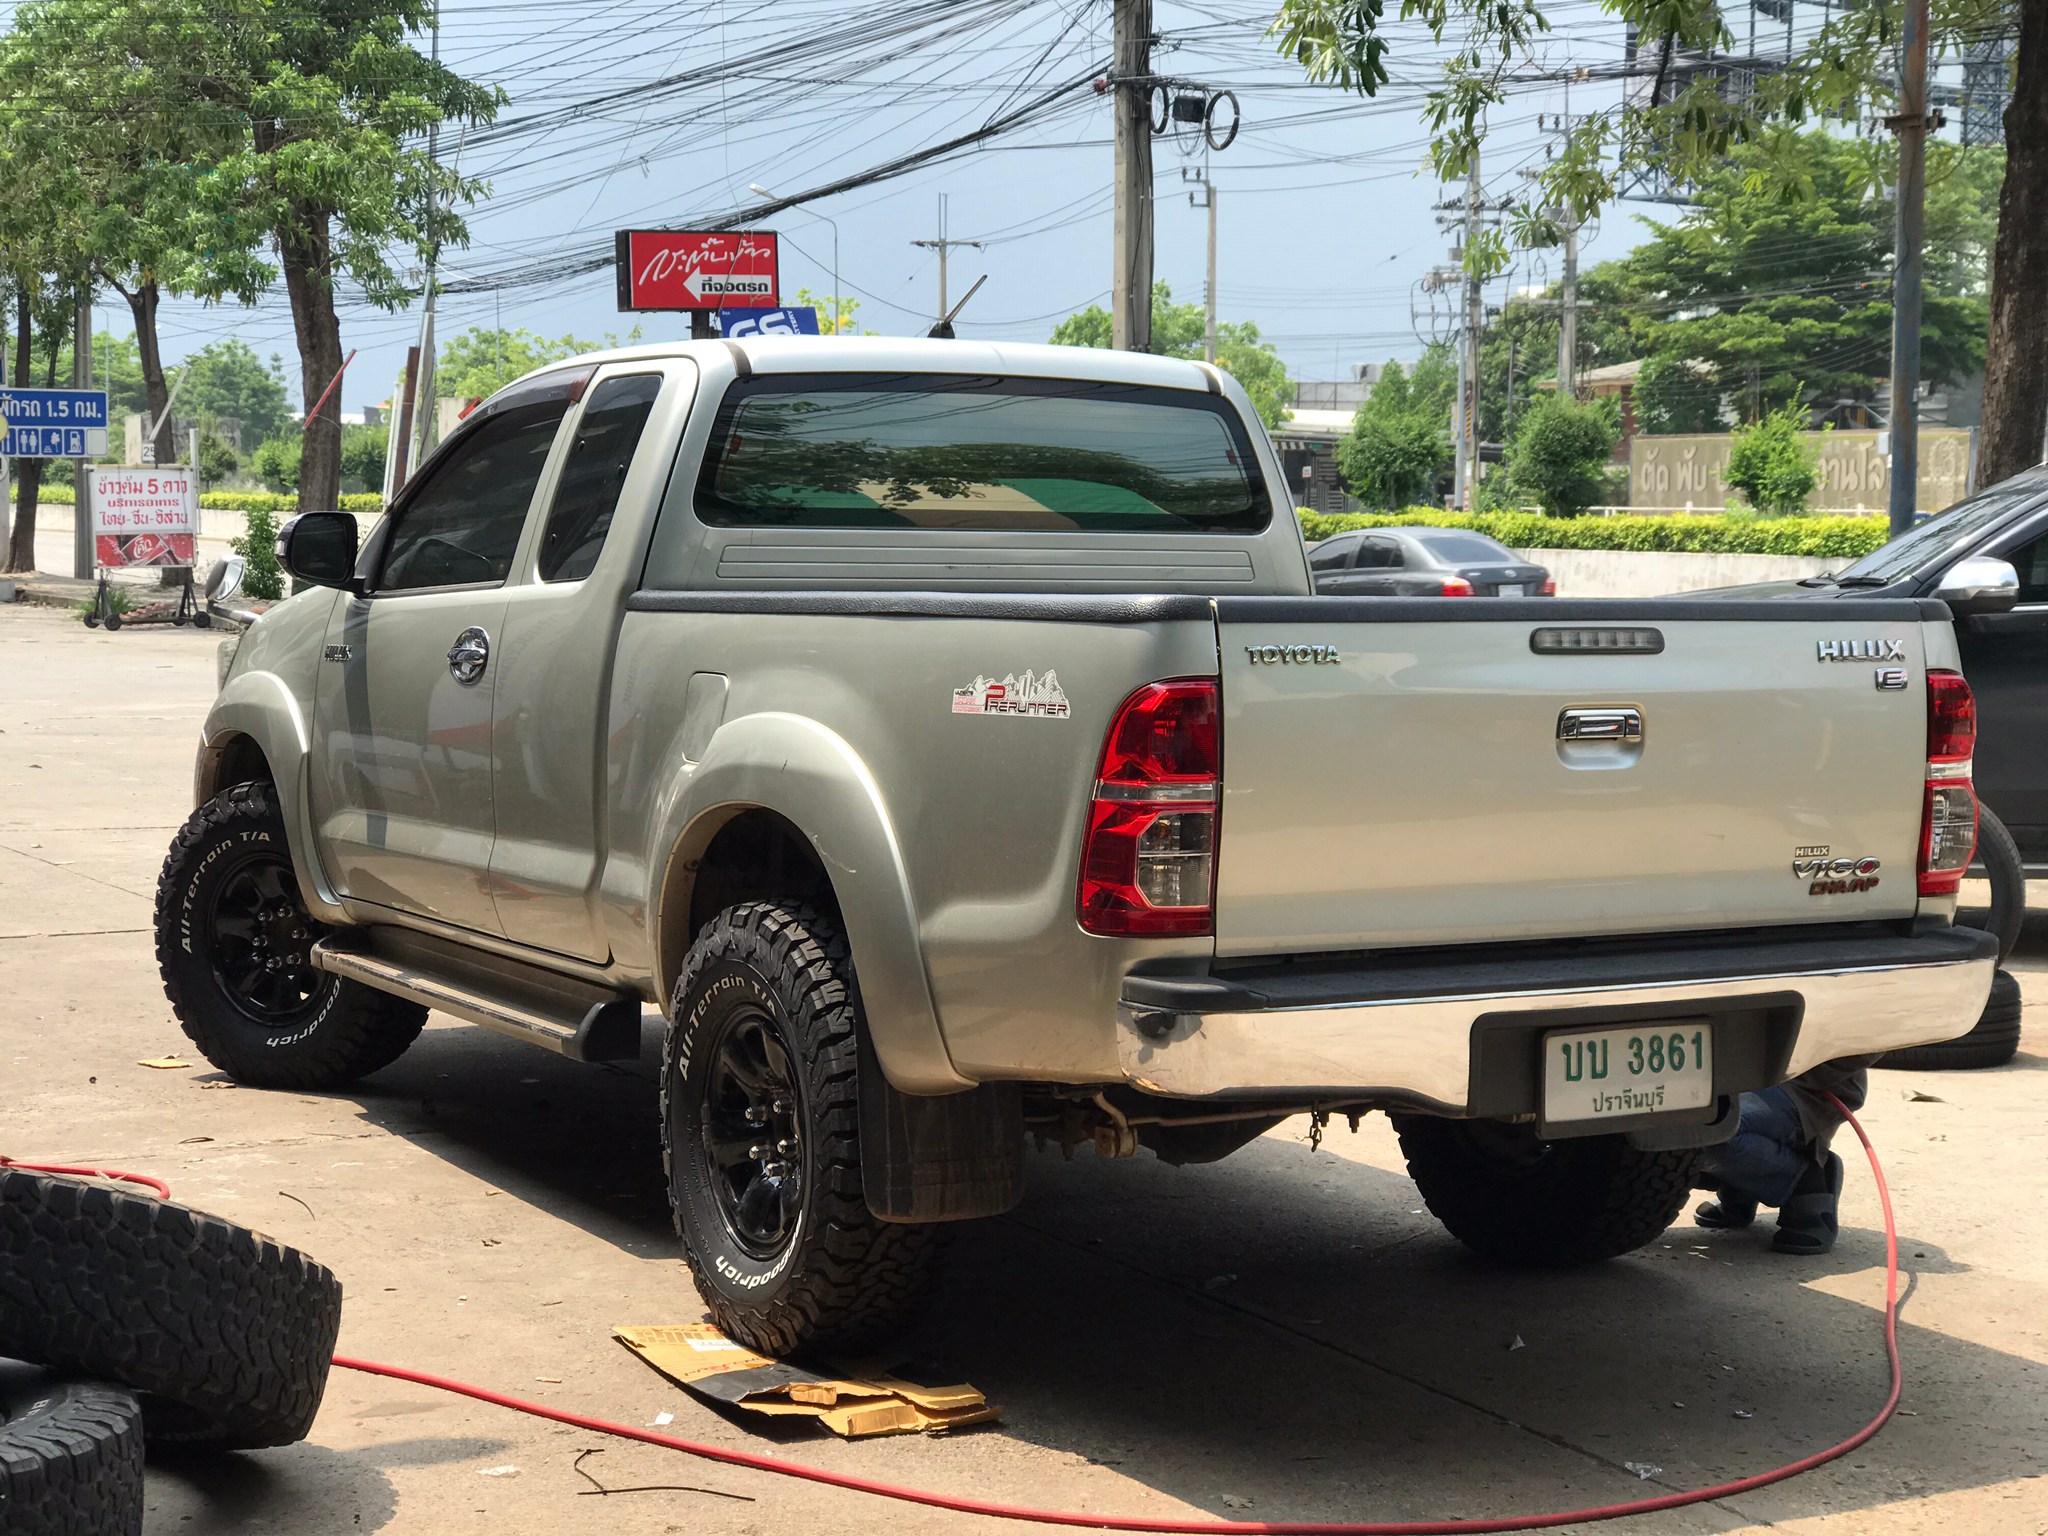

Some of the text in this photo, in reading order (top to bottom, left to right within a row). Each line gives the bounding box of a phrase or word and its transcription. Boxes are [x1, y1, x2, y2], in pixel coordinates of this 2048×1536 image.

[701, 277, 769, 293] ที่จอดรถ
[47, 401, 69, 418] 1.5
[75, 401, 102, 418] กม.
[99, 476, 188, 495] ข้าวต้ม 5 ดาว
[108, 498, 179, 507] บริการอาหาร
[1245, 644, 1341, 665] TOYOTA
[1817, 639, 1906, 662] HILUX
[1795, 846, 1829, 857] HILUX
[1793, 856, 1881, 878] VIGO
[180, 830, 271, 953] All-Terrain T/A
[266, 974, 342, 1047] Goodrich
[679, 973, 777, 1081] All-Terrain T/A
[1562, 1031, 1703, 1082] บบ 3861
[1592, 1085, 1665, 1113] ปราจีนบุรี
